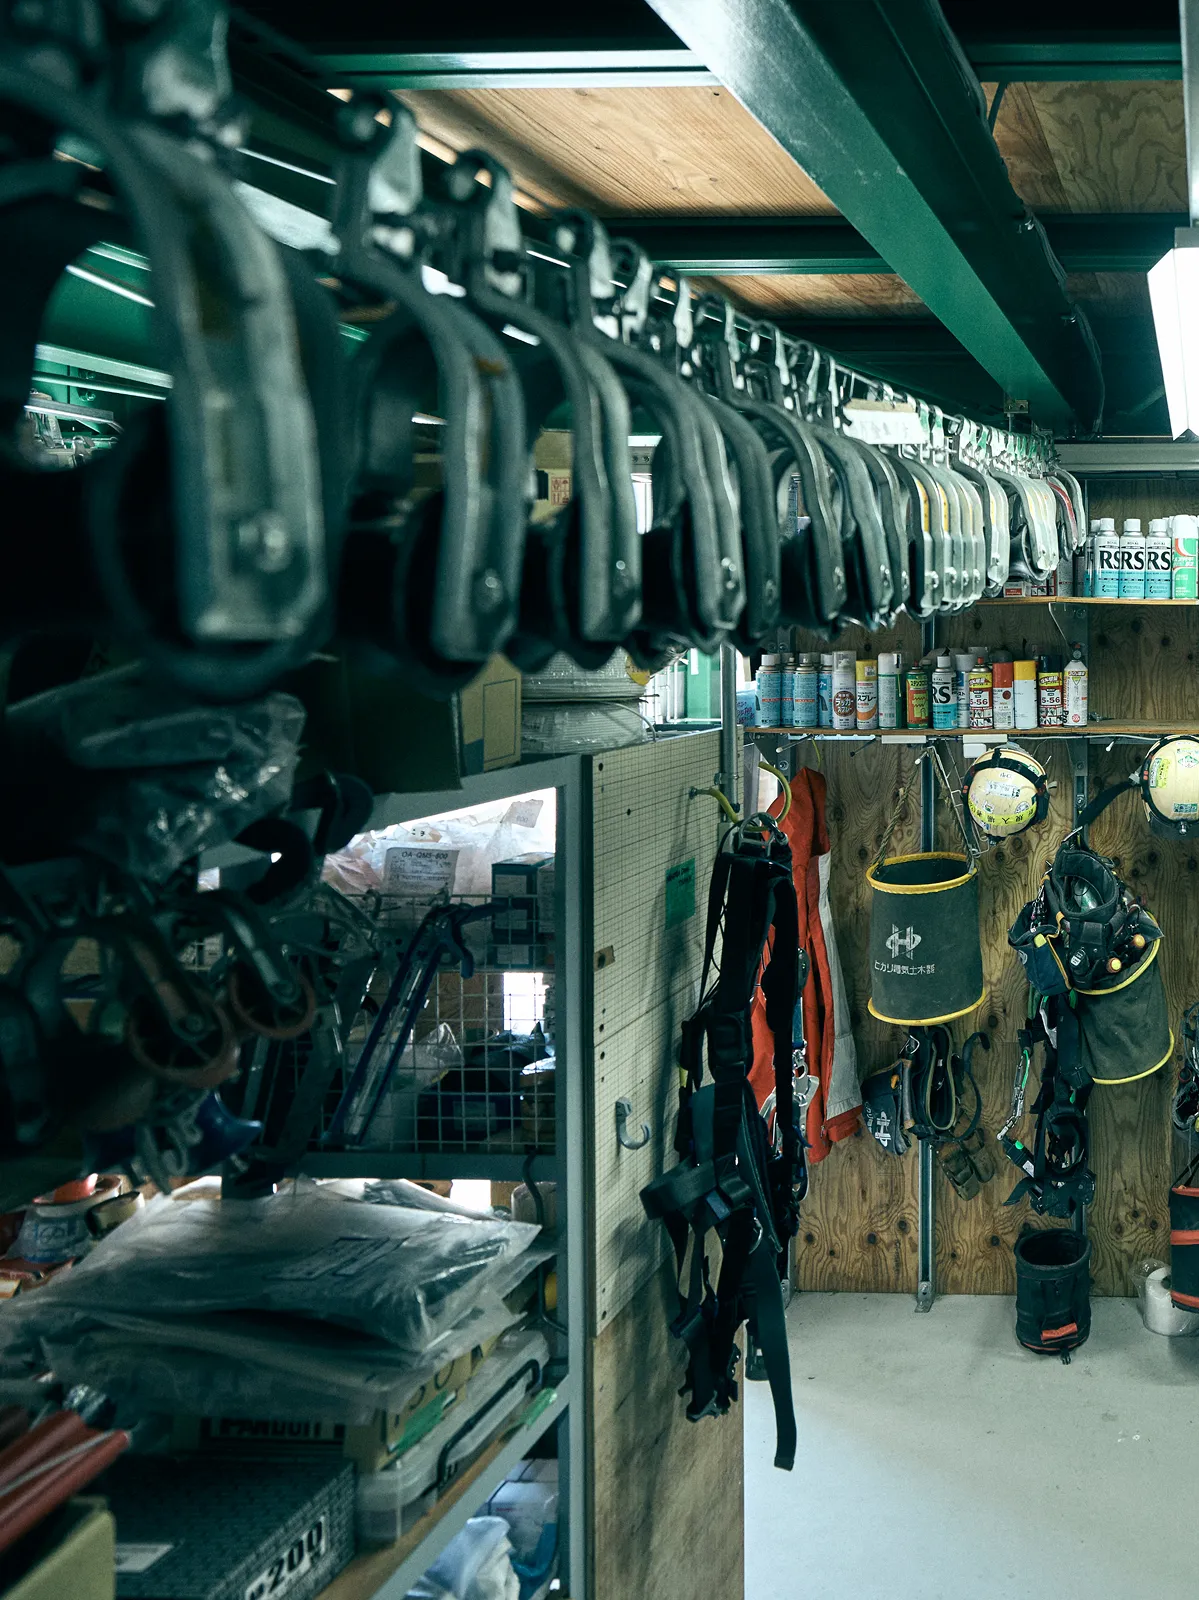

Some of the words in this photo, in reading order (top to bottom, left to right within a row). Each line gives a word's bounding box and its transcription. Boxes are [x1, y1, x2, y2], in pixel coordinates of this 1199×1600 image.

[1119, 551, 1144, 570] RS
[1147, 551, 1171, 570] RS
[857, 694, 877, 702] スプレー
